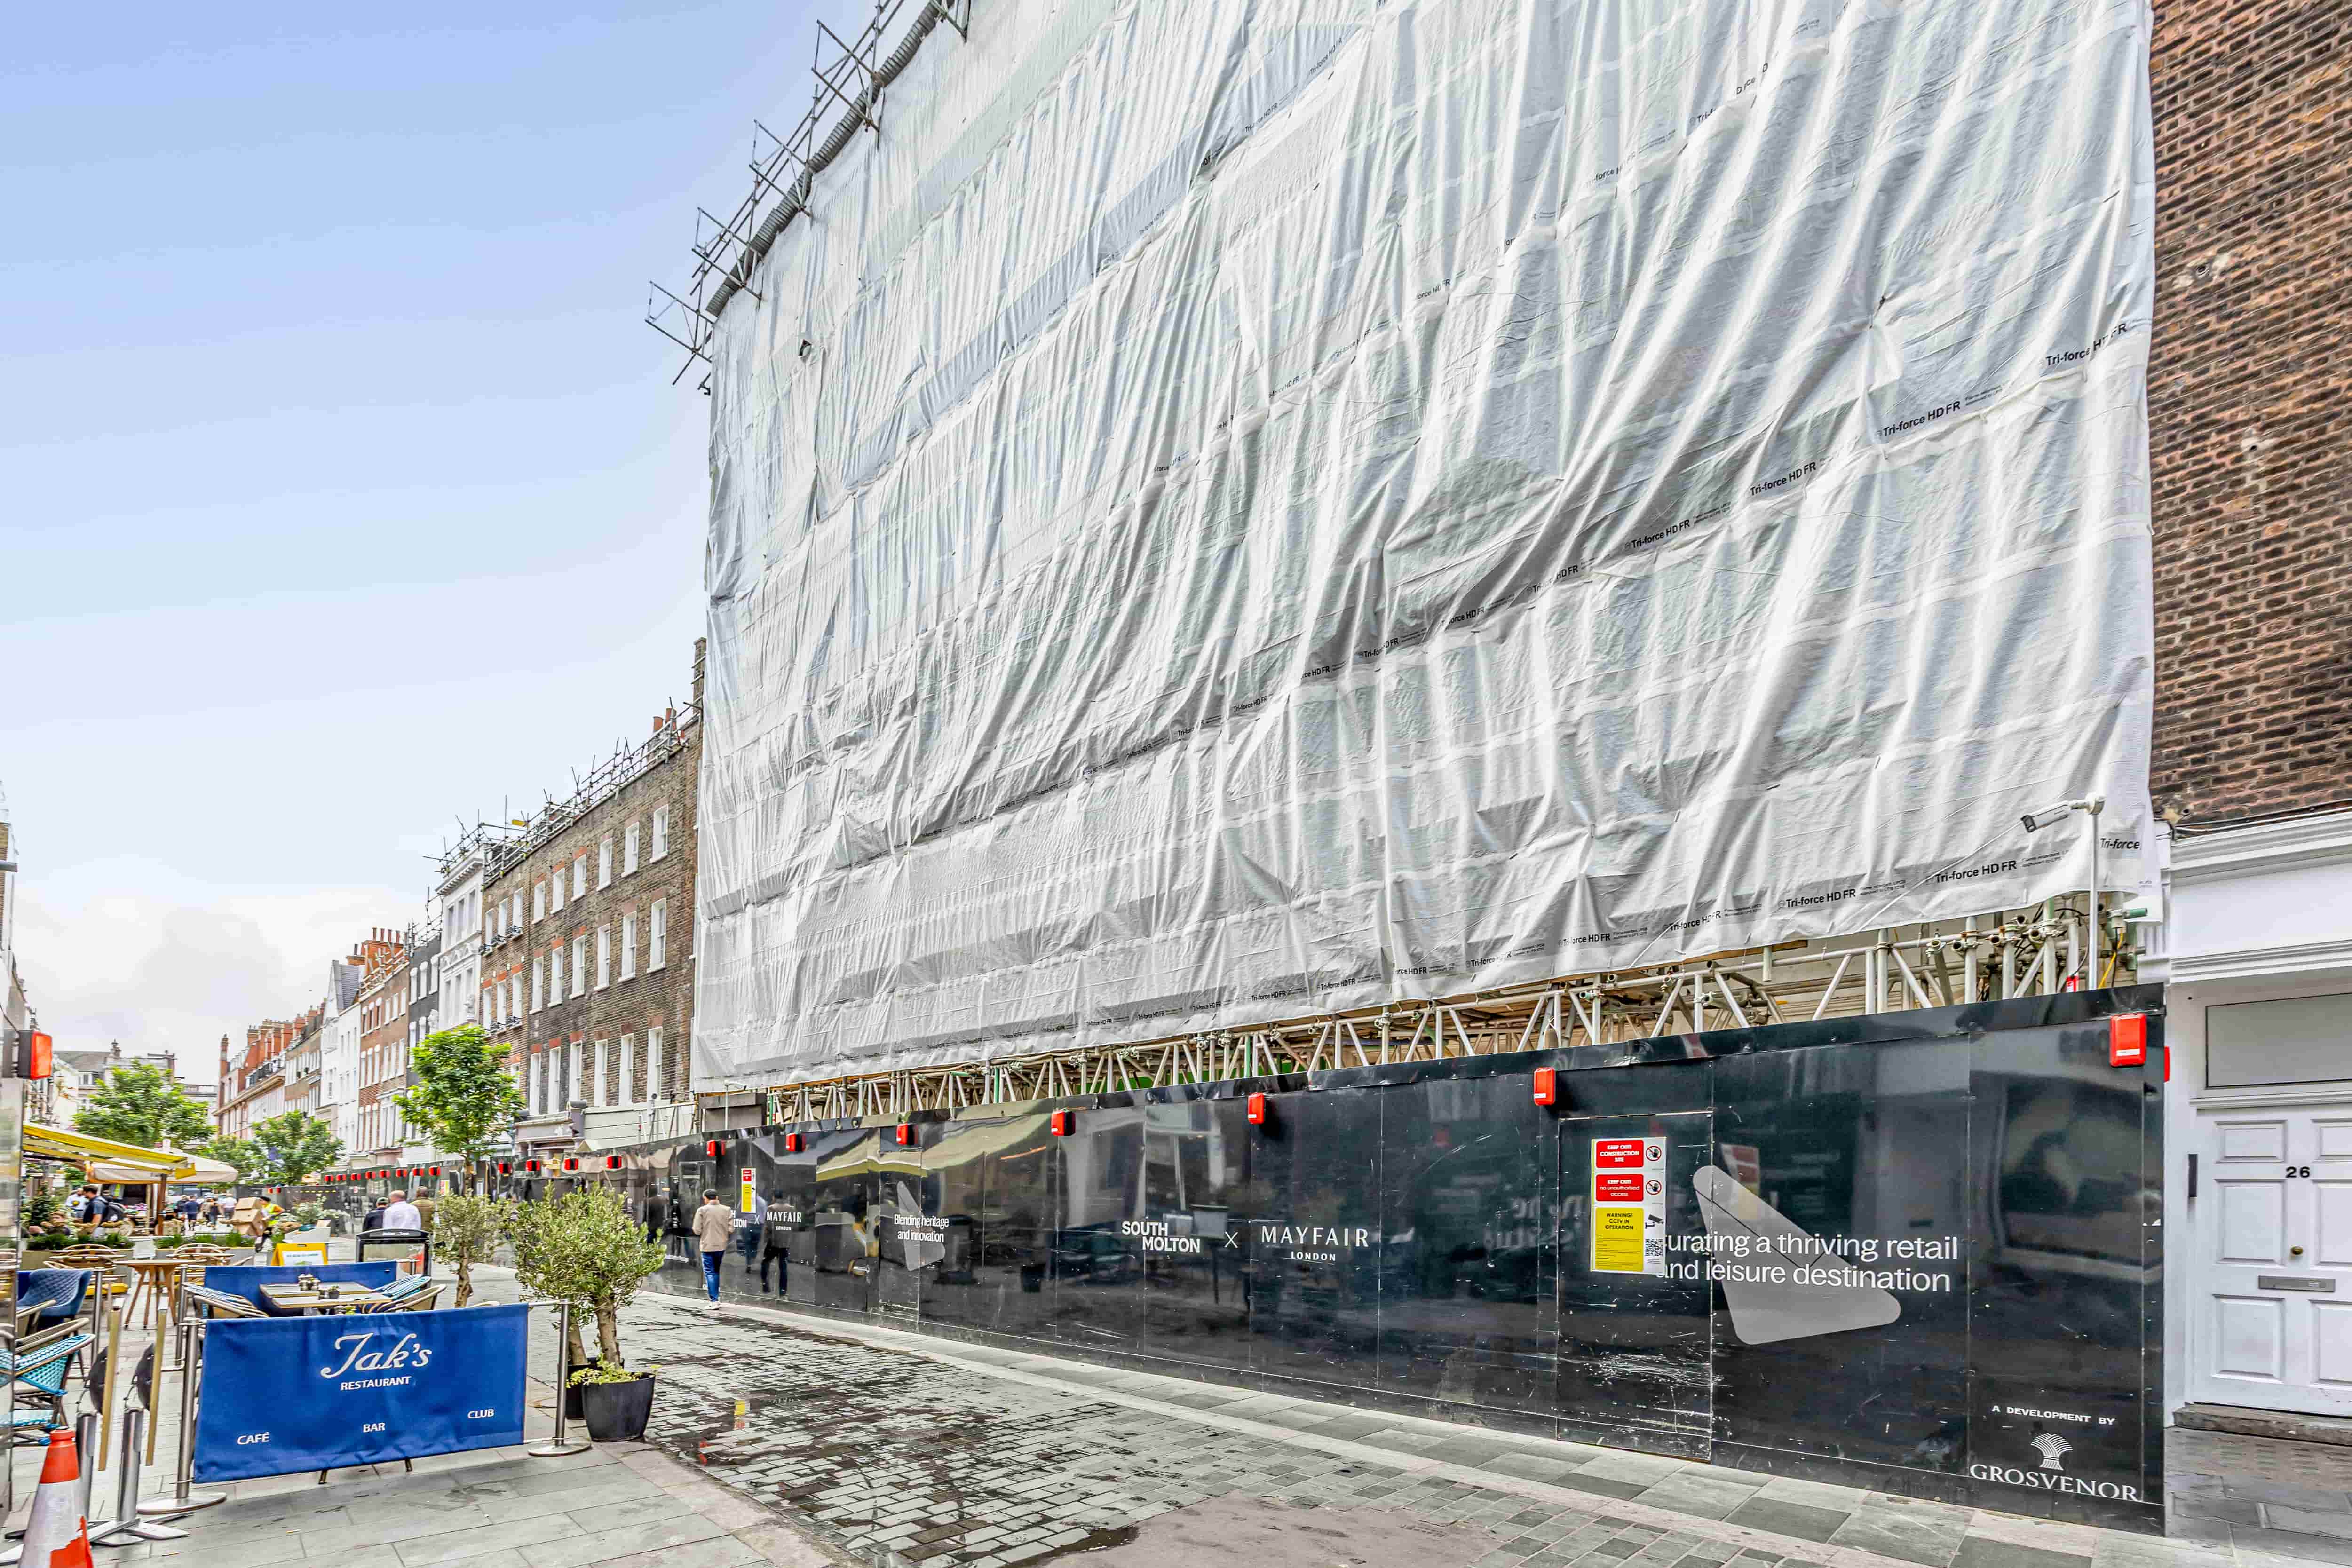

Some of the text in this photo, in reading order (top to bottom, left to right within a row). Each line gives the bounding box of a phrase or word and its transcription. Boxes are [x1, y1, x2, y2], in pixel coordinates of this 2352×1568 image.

[2046, 348, 2090, 366] Tri-force
[1883, 400, 1961, 437] Tri-force HD FR
[1750, 462, 1816, 496] Tri-force HD FR
[1631, 519, 1690, 548] Tri-force HD FR
[1556, 565, 1578, 580] HD FR
[1466, 610, 1476, 619] HD
[1322, 665, 1330, 674] FR
[2099, 838, 2140, 850] Tri-force
[1935, 860, 2017, 883] Tri-force HD FR
[1786, 889, 1855, 908] Tri-force HD FR
[1588, 934, 1600, 942] HD
[1600, 933, 1611, 941] FR
[2286, 1166, 2311, 1178] 26
[733, 1219, 747, 1228] LTON
[766, 1211, 802, 1223] MAYFAIR
[894, 1213, 950, 1229] Blending heritage
[897, 1230, 944, 1242] and innovation
[1122, 1221, 1168, 1236] SOUTH
[1261, 1225, 1369, 1247] MAYFAIR
[1142, 1236, 1201, 1253] MOLTON
[1665, 1231, 1750, 1257] urating
[1756, 1235, 1772, 1253] a
[1777, 1233, 1879, 1262] thriving
[1887, 1236, 1958, 1260] retail
[1291, 1251, 1336, 1261] LONDON
[1706, 1259, 1786, 1283] leisure
[1793, 1263, 1950, 1292] destination
[320, 1332, 433, 1378] Jak's
[341, 1375, 412, 1391] RESTAURANT
[467, 1408, 495, 1420] CLUB
[2006, 1406, 2091, 1423] DEVELOPMENT
[2098, 1417, 2116, 1425] BY
[363, 1422, 386, 1433] BAR
[237, 1431, 270, 1445] CAFÉ
[1970, 1464, 2138, 1502] GROSVENOR
